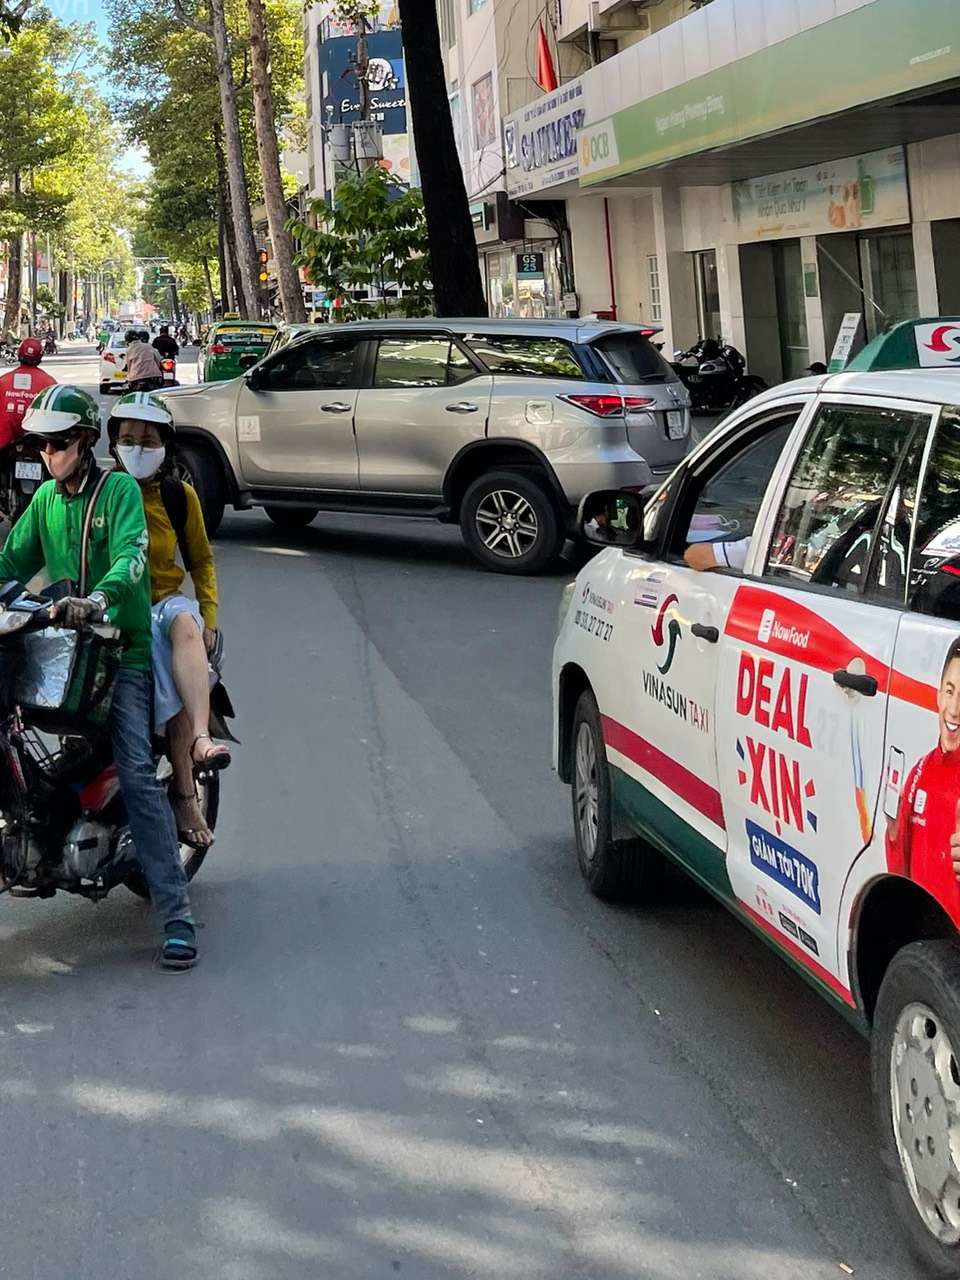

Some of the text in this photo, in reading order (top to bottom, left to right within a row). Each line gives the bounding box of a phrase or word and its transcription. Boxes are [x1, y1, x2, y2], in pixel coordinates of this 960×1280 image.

[591, 132, 609, 161] OCB
[522, 254, 537, 263] GS
[523, 263, 537, 272] 25
[772, 621, 810, 649] NowFood
[642, 670, 709, 733] VINASUN TAXI
[737, 651, 812, 749] DEAL
[746, 736, 804, 836] XỊN
[752, 833, 816, 902] GIẢM TỚI 70K
